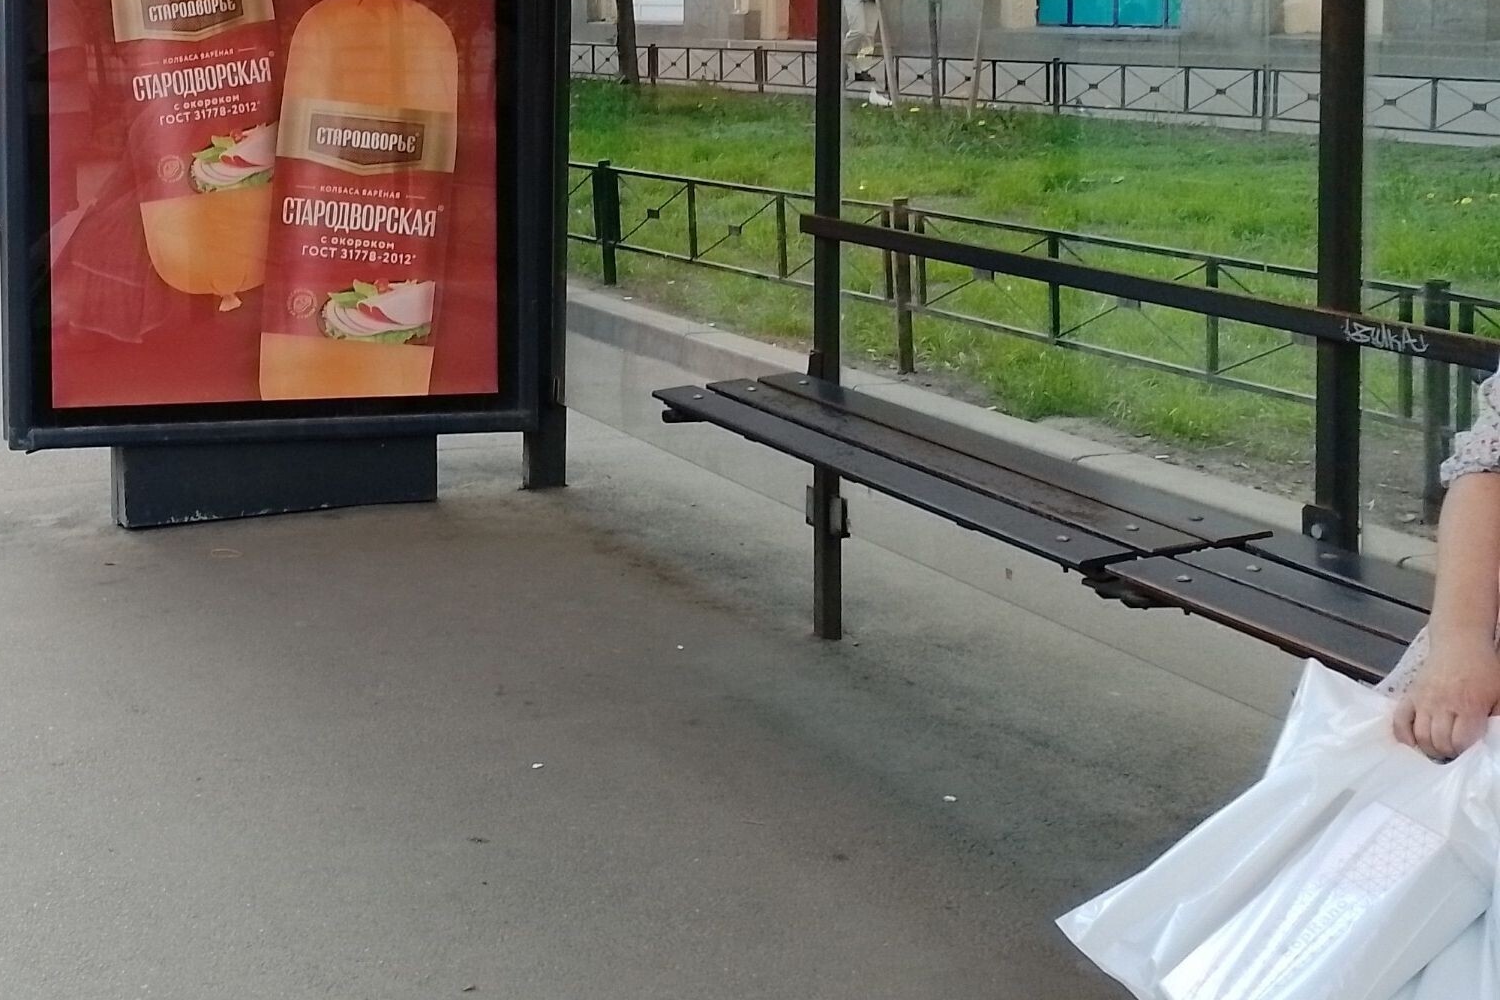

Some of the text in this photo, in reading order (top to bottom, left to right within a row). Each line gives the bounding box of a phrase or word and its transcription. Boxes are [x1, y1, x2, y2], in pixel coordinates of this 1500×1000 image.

[162, 54, 199, 65] КОЛБАСА
[132, 57, 272, 102] СТАРОДВОРСКАЯ
[183, 94, 240, 111] окороком
[159, 111, 191, 126] ГОСТ
[320, 185, 360, 196] КОЛБАСА
[282, 197, 437, 237] СТАРОДВОРСКАЯ
[331, 236, 395, 250] окороком
[301, 245, 337, 258] ГОСТ
